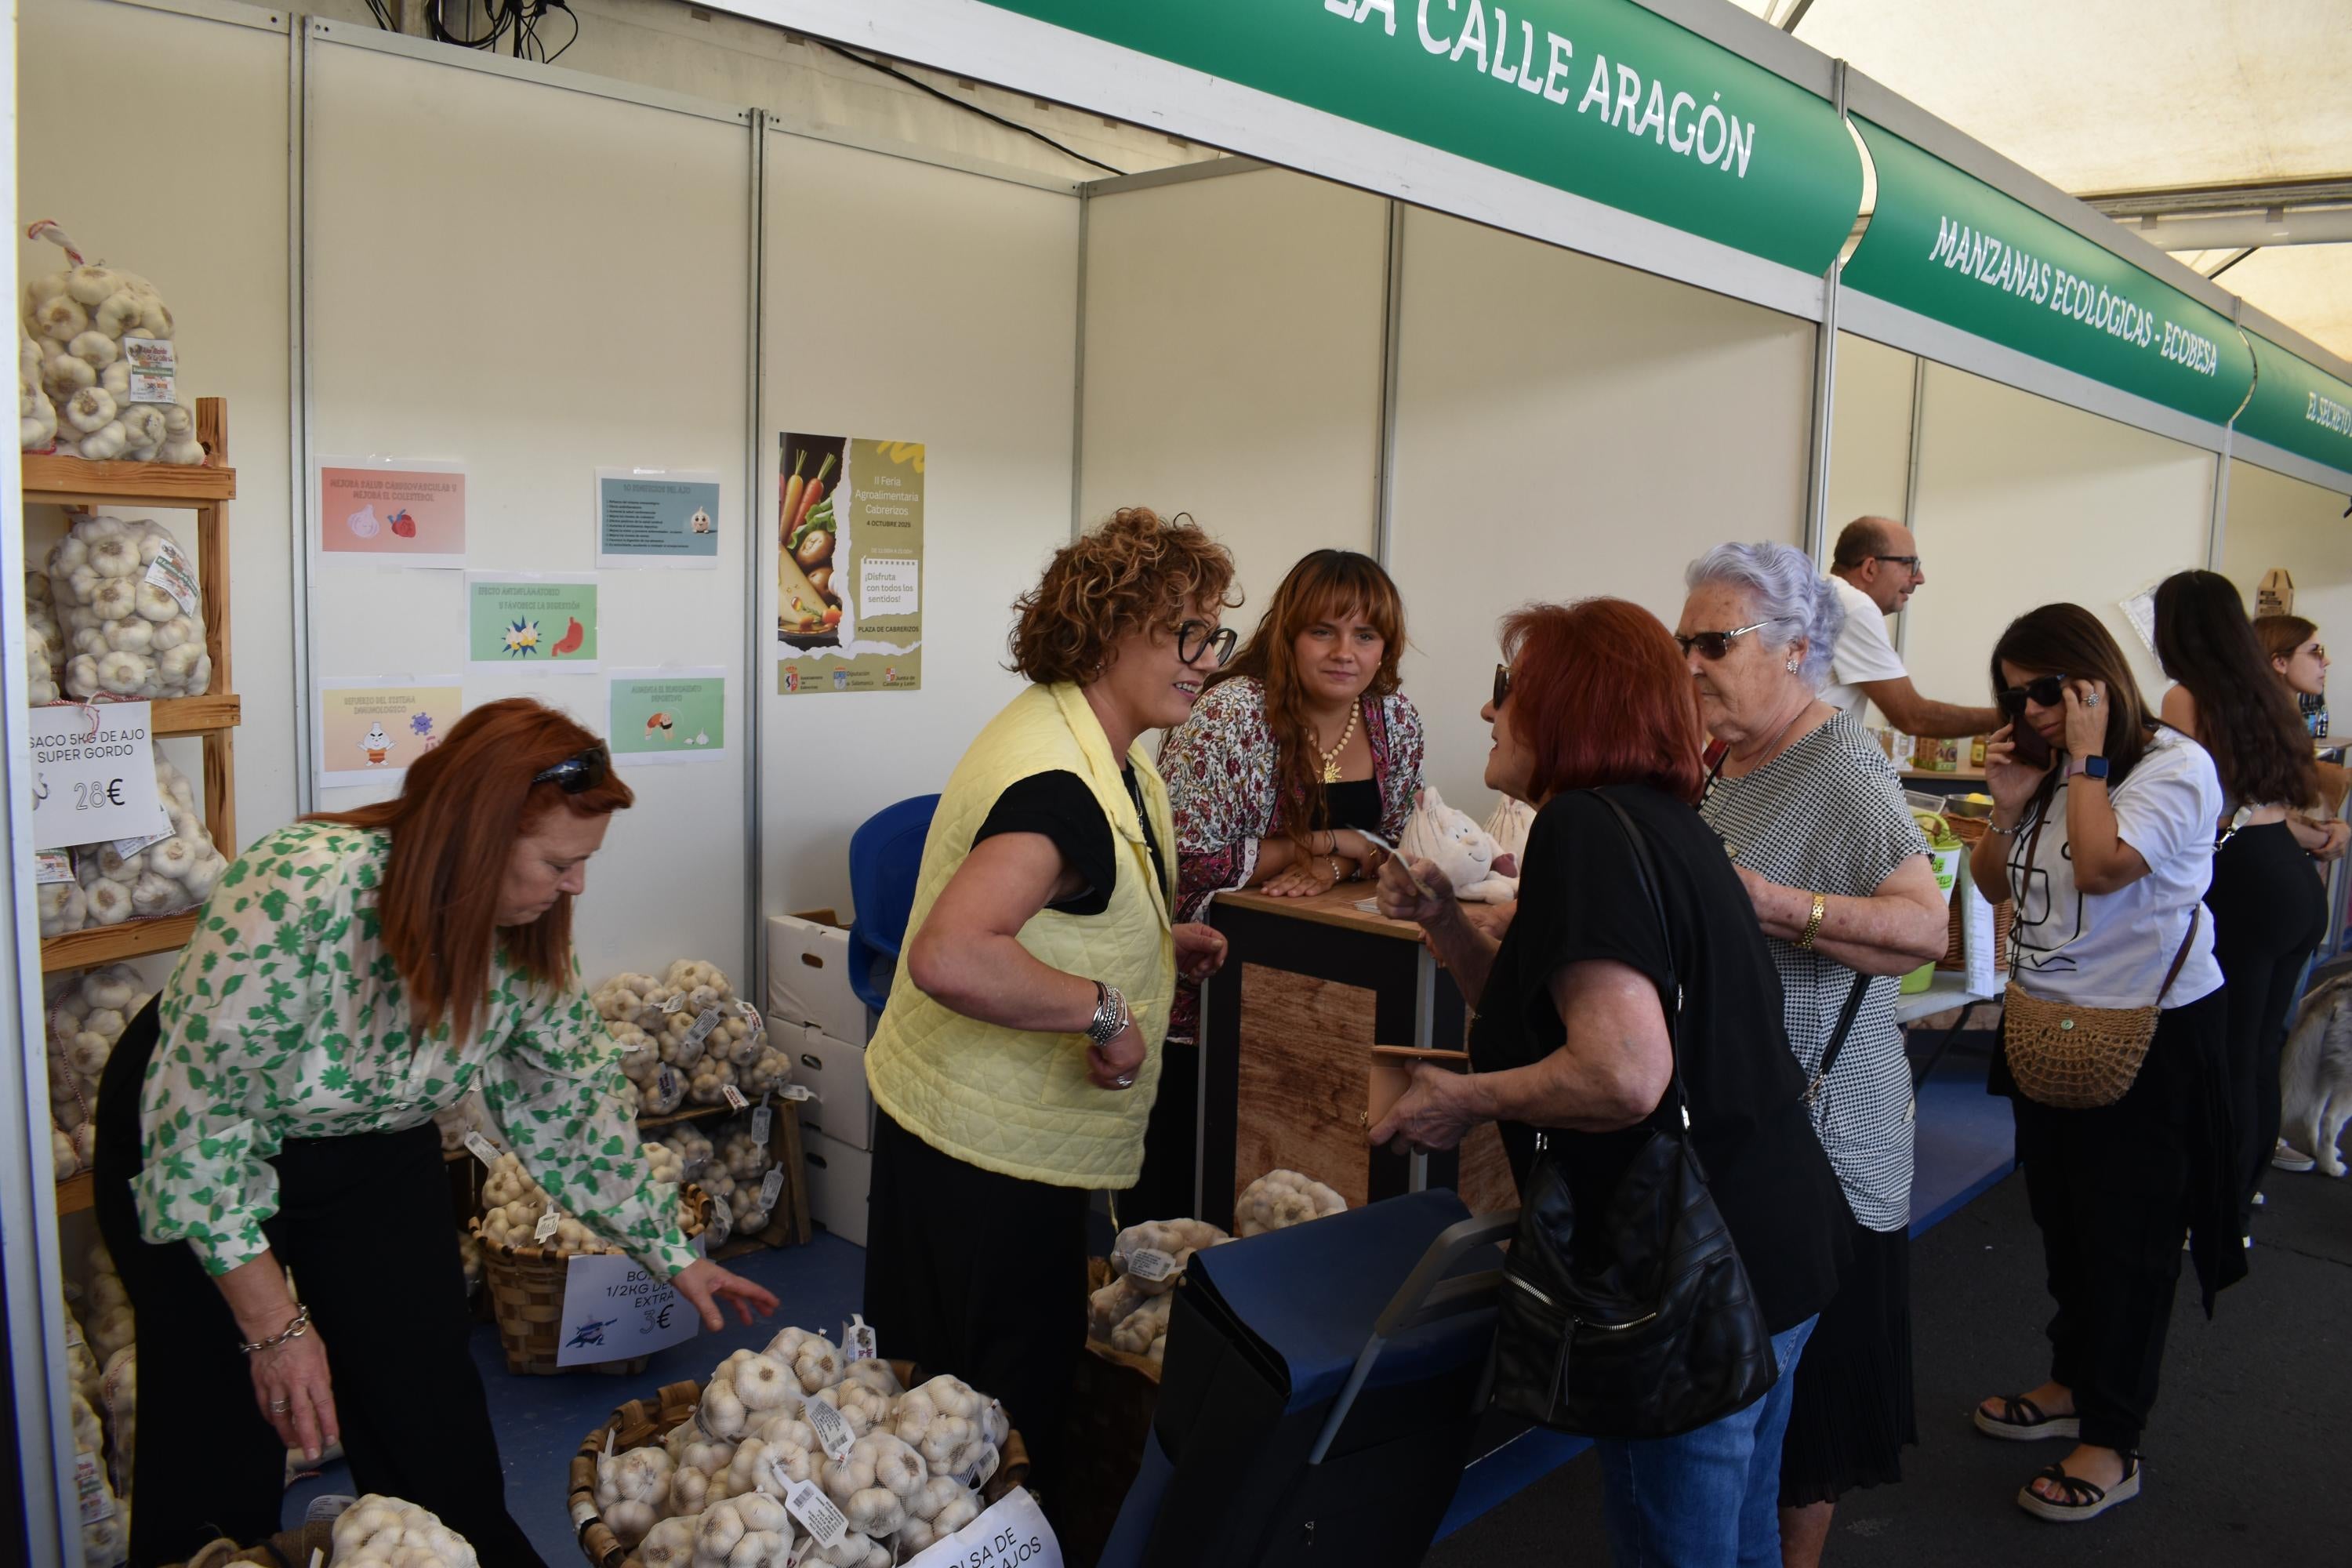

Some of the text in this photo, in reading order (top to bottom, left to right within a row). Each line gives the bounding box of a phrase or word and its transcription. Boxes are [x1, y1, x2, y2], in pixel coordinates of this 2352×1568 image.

[1417, 0, 1573, 105] CALLE
[1578, 53, 1755, 179] ARAGÓN
[1929, 216, 2051, 304] MANZANAS
[2050, 269, 2154, 349] ECOLÓGICAS
[2161, 321, 2217, 377] ECOBESA
[2306, 391, 2351, 436] EL SECRETO
[874, 476, 902, 487] II Feria
[855, 488, 919, 502] Agroalimentaria
[866, 503, 909, 516] Cabrerizos
[865, 572, 896, 582] ¡Disfruta
[881, 583, 902, 592] todos
[903, 583, 914, 592] los
[70, 732, 96, 746] 5KG
[100, 730, 117, 743] DE
[121, 728, 145, 741] AJO
[38, 744, 134, 764] SUPER GORDO
[74, 778, 125, 811] 28€
[606, 1283, 649, 1298] 1/2KG
[635, 1290, 674, 1308] EXTRA
[640, 1303, 674, 1334] 3€
[994, 1526, 1017, 1554] DE
[1003, 1536, 1041, 1568] AJOS
